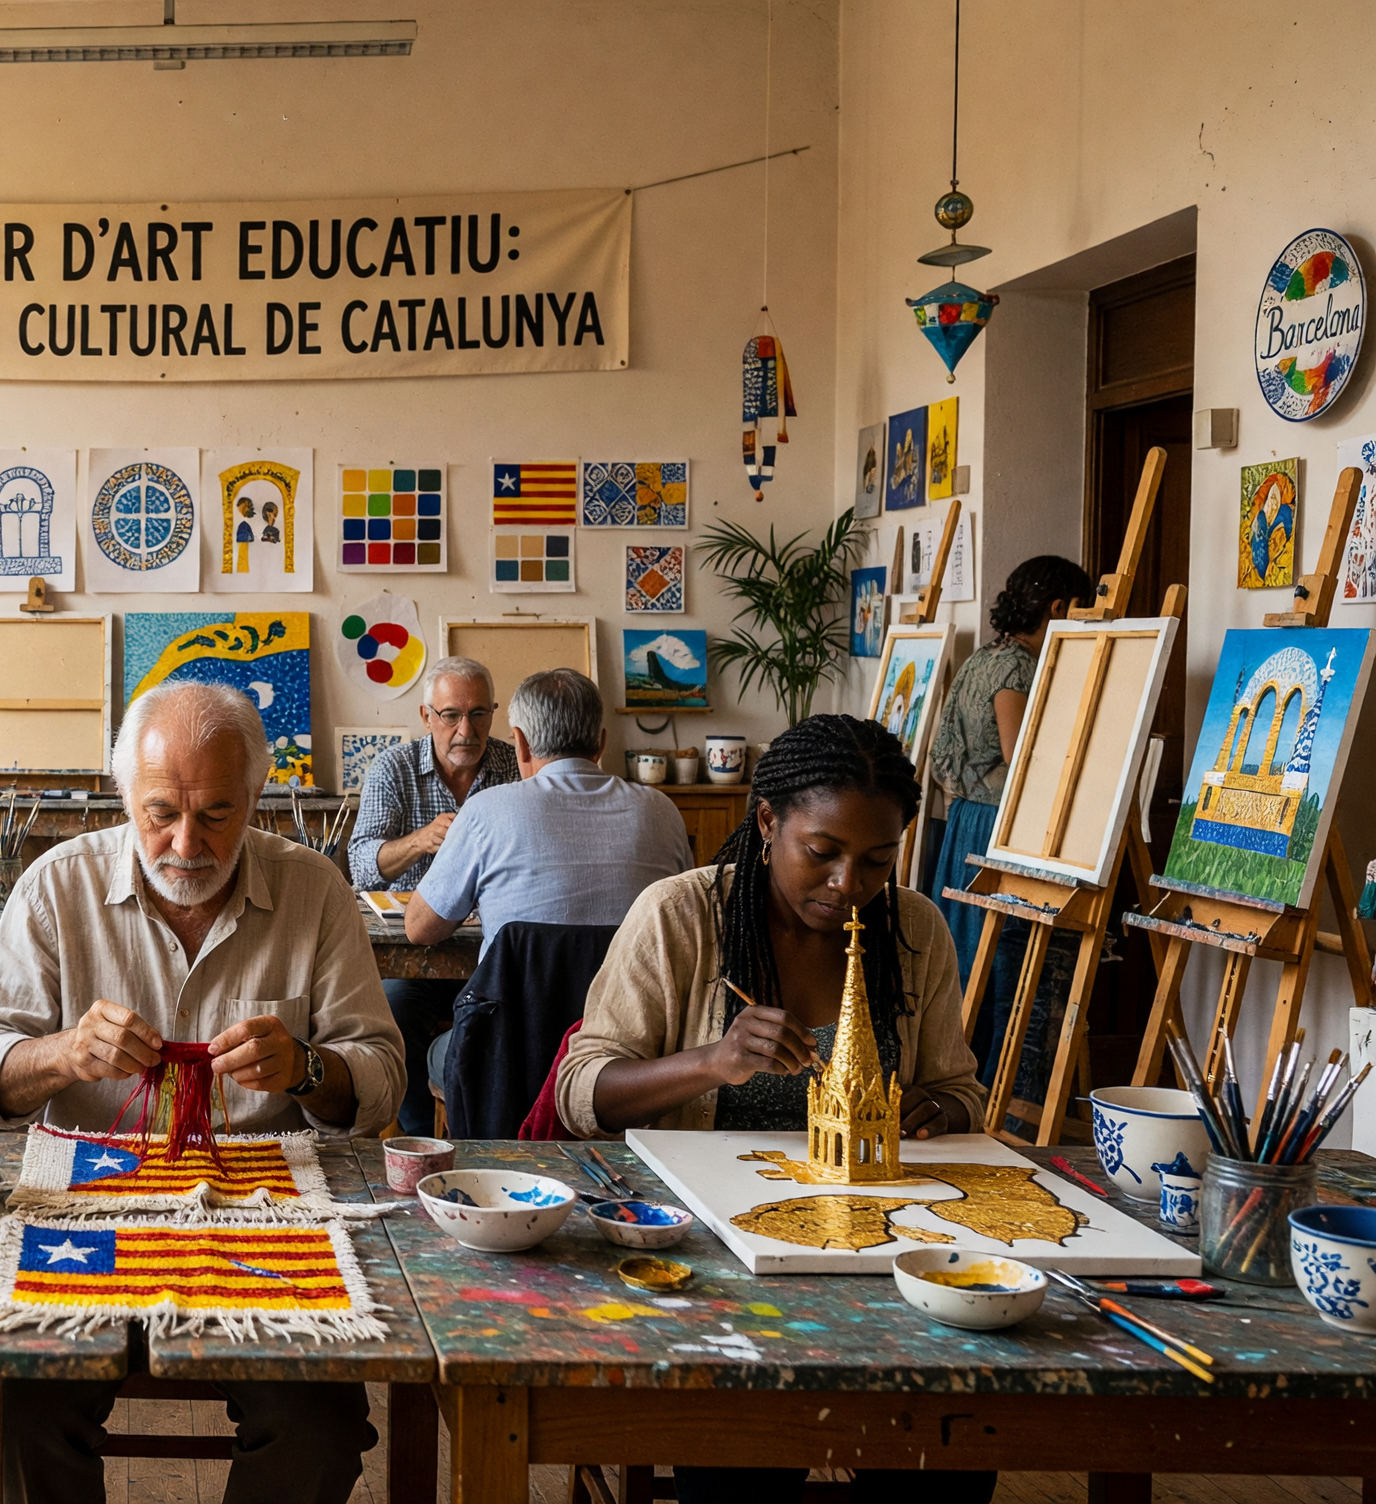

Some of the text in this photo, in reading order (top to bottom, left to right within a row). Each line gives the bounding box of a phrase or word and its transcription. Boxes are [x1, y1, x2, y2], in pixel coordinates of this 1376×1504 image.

[62, 217, 214, 282] D'ART
[238, 212, 521, 281] EDUCATIU:
[18, 302, 247, 357] CULTURAL
[266, 301, 322, 356] DE
[340, 291, 605, 354] CATALUNYA
[1260, 293, 1360, 360] Barcelona
